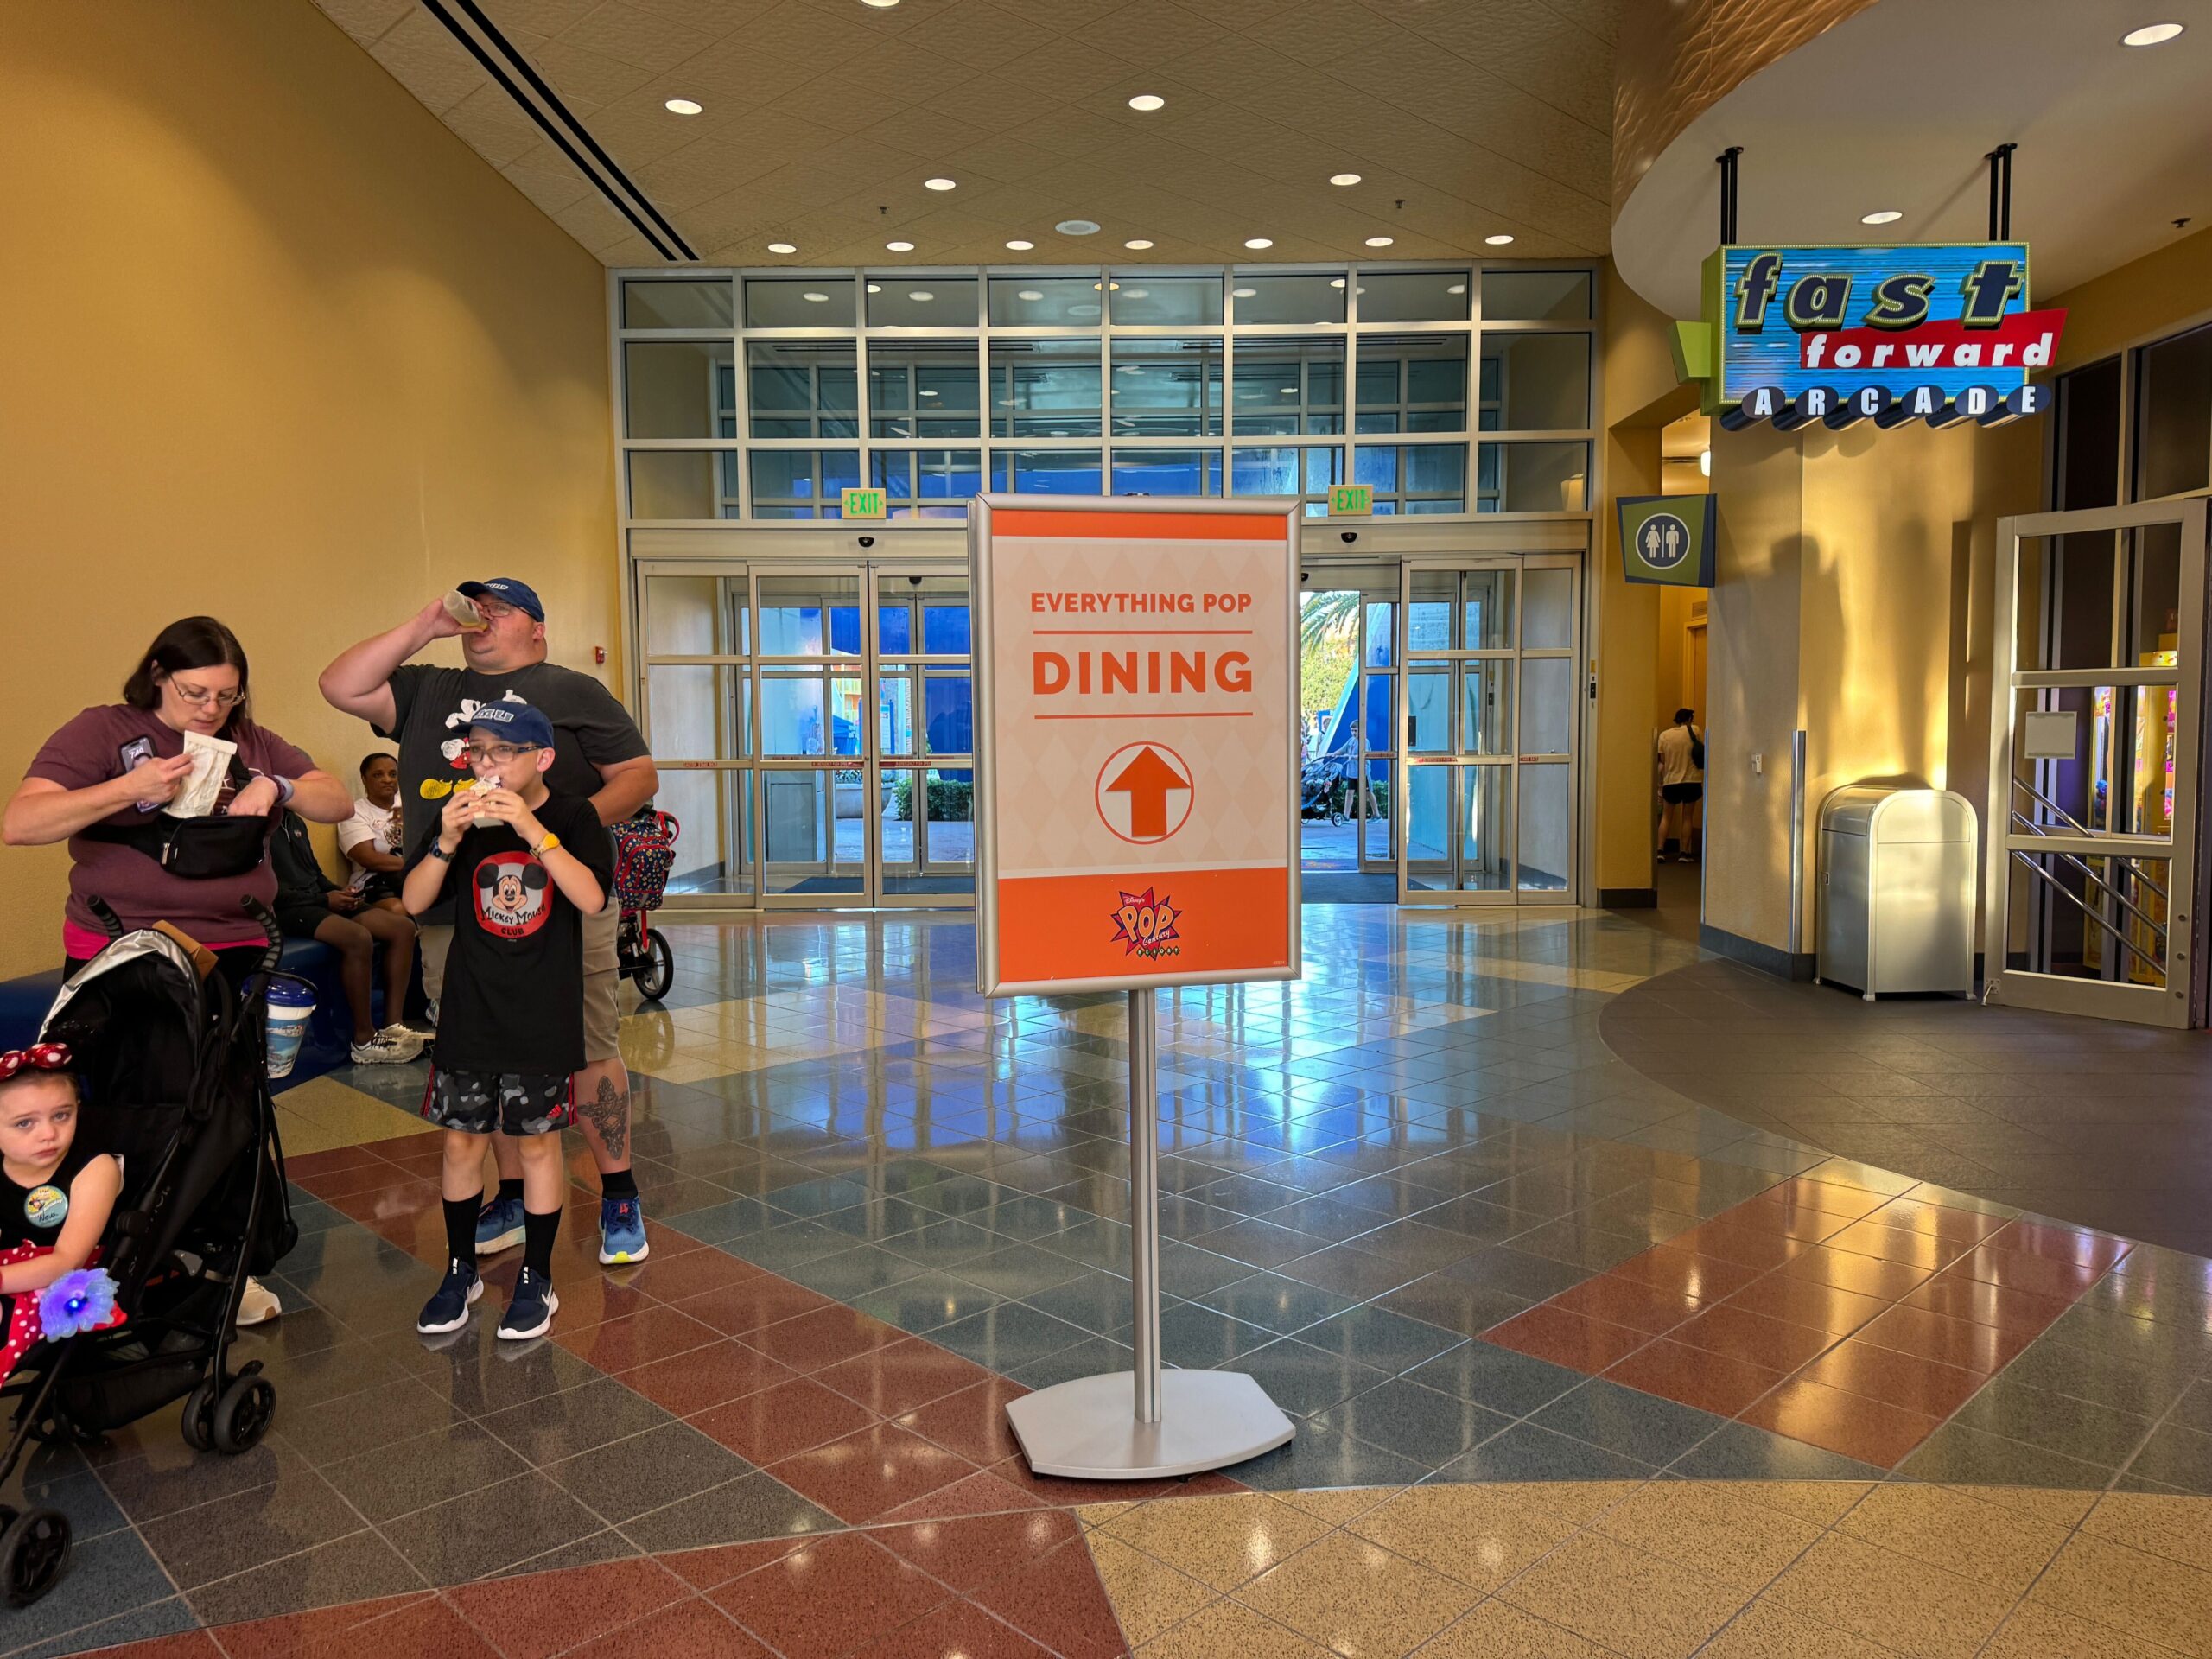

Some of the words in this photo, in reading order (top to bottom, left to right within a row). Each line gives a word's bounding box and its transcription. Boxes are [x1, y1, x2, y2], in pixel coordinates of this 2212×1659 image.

[1733, 251, 2024, 329] fast
[1806, 332, 2054, 368] forward
[1753, 385, 2037, 416] ARCADE
[849, 493, 878, 515] EXIT
[1336, 489, 1365, 512] EXIT
[1031, 592, 1195, 613] EVERYTHING
[1203, 593, 1253, 613] POP
[1033, 651, 1253, 695] DINING
[500, 927, 525, 937] CLUB
[1117, 904, 1175, 943] POP
[1142, 930, 1170, 946] Century
[1137, 947, 1179, 956] RESORT
